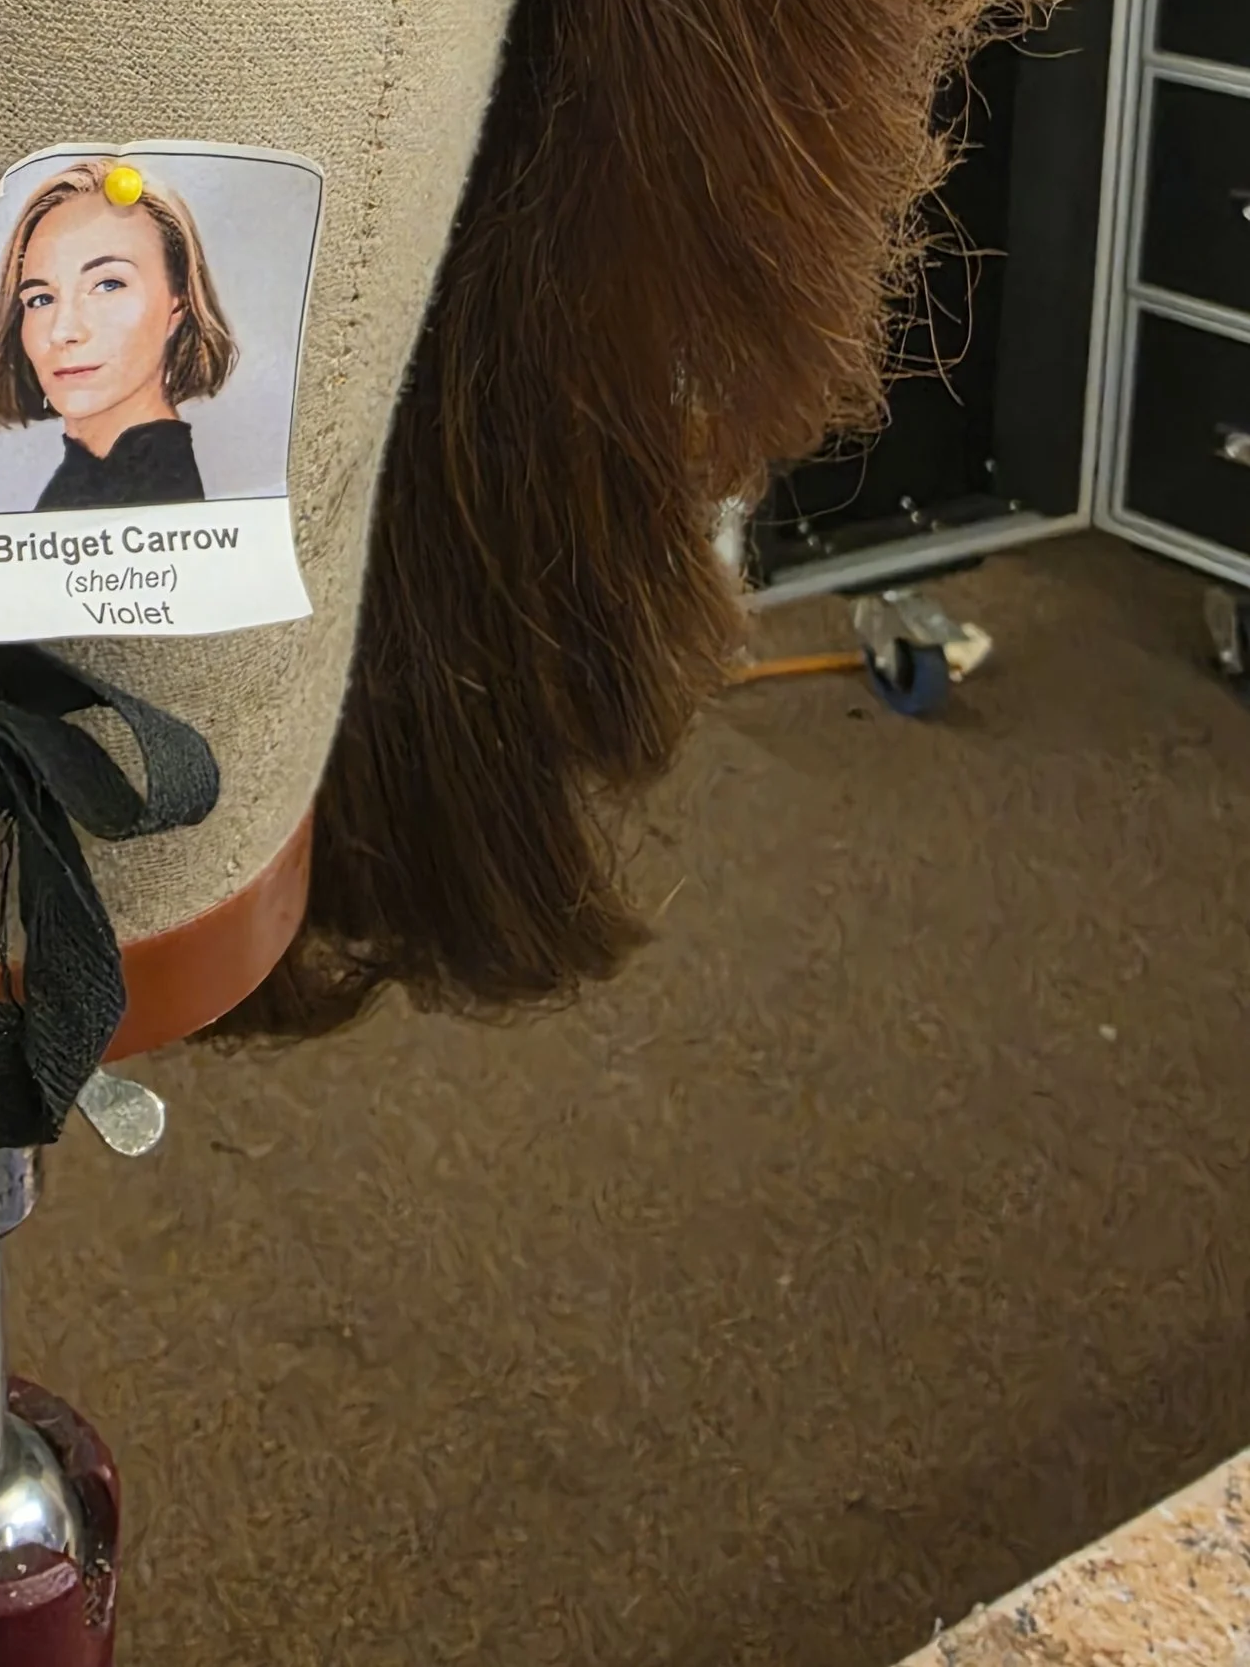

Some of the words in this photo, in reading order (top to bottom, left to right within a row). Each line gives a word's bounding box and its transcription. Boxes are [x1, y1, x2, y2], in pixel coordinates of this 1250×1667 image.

[122, 525, 239, 554] Carrow
[65, 564, 178, 597] (she/her)
[82, 601, 175, 625] Violet
